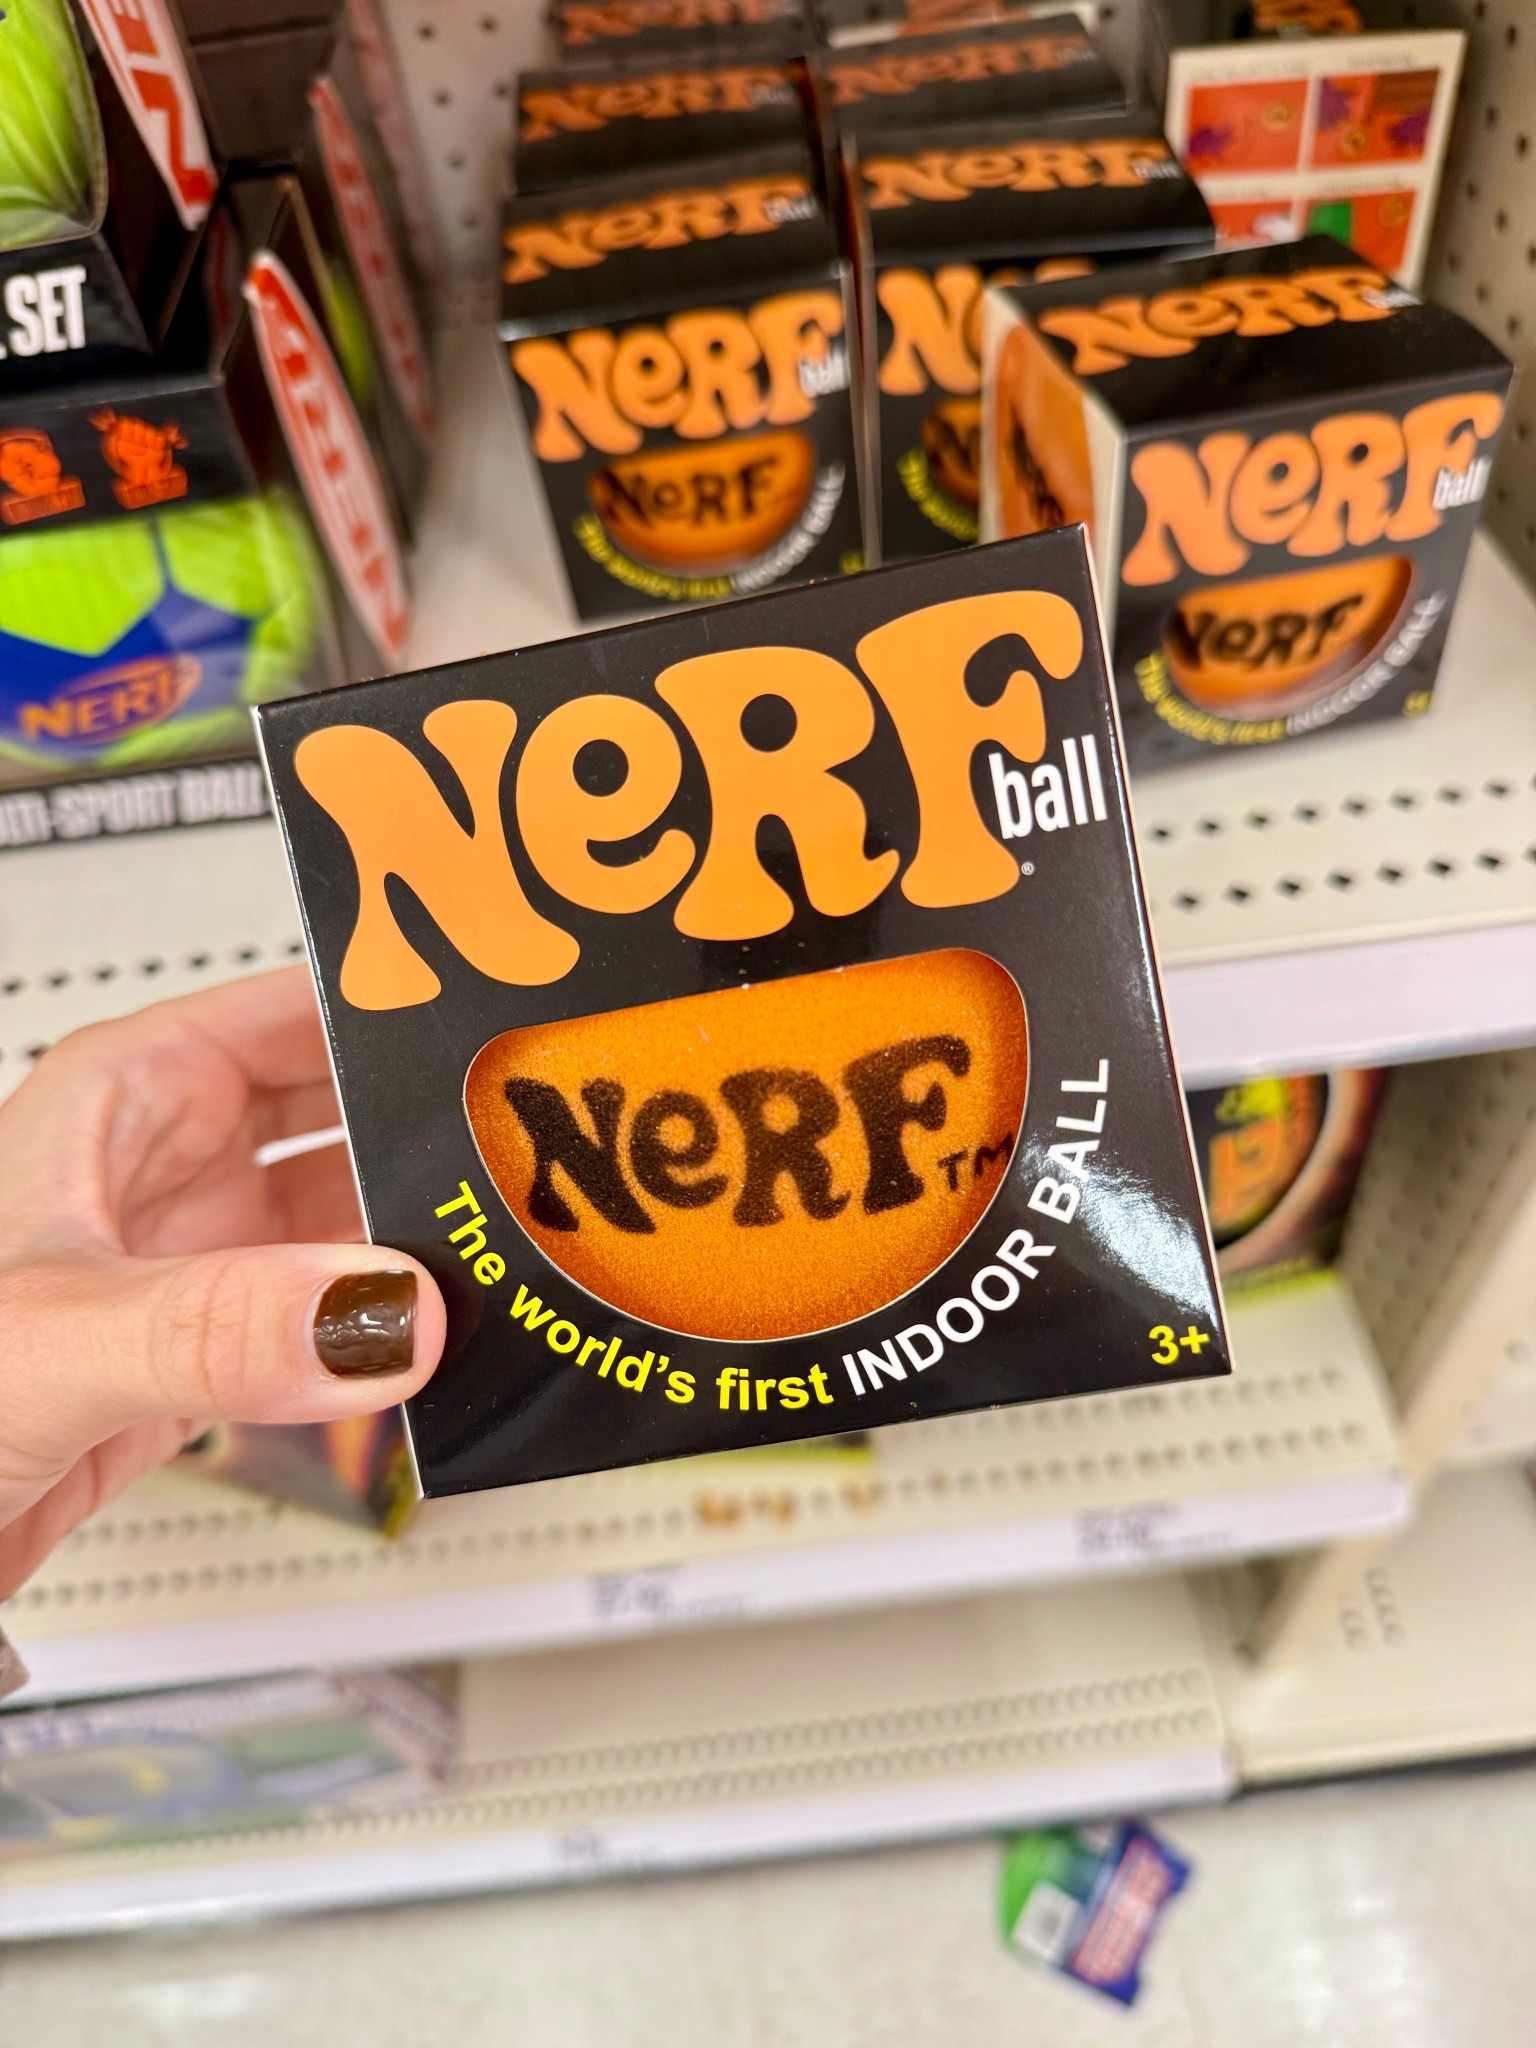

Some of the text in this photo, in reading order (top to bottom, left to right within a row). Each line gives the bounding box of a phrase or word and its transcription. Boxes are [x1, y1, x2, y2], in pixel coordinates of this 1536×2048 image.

[4, 264, 87, 358] SET
[988, 733, 1108, 840] ball
[434, 1180, 507, 1286] The
[509, 1283, 697, 1404] world's
[715, 1362, 833, 1412] first
[842, 1228, 1056, 1397] INDOOR
[1026, 1058, 1109, 1225] BALL
[1148, 1325, 1210, 1365] 3+
